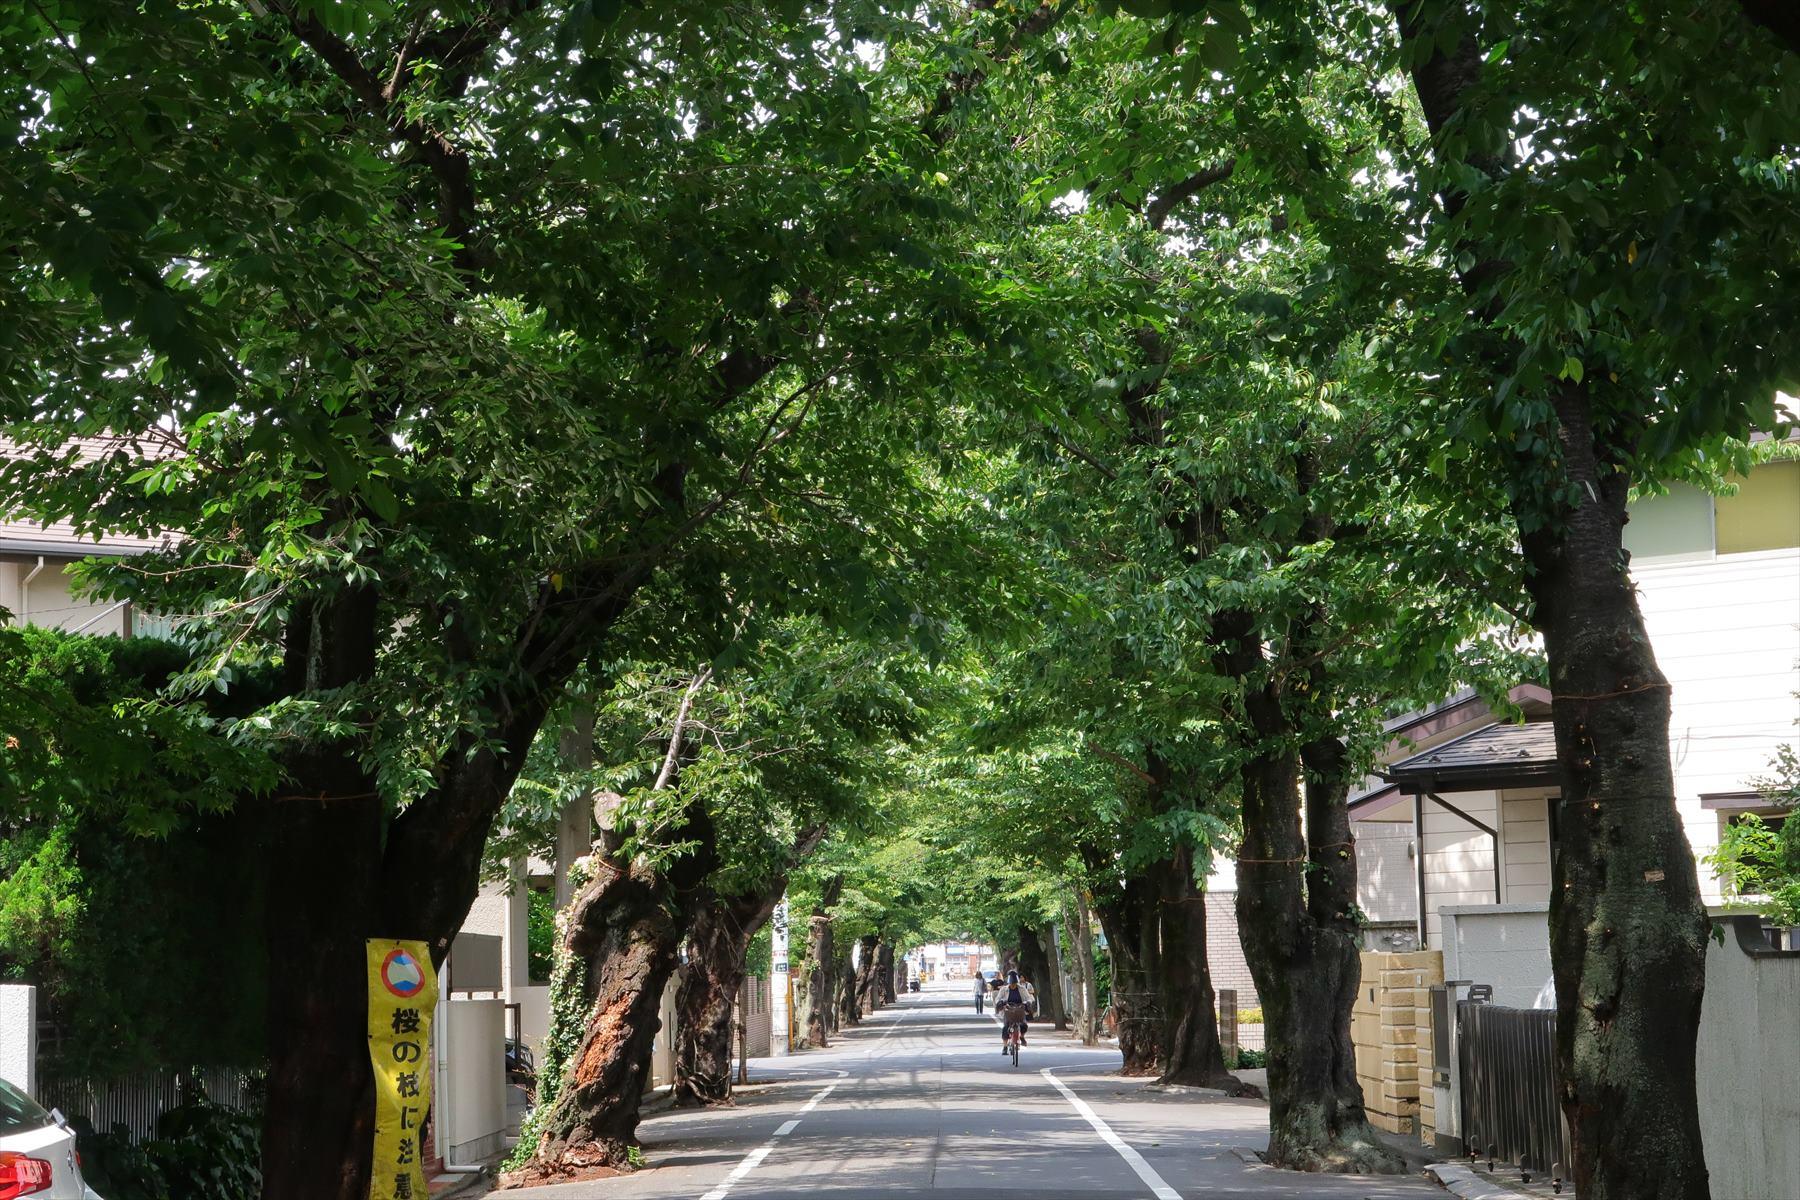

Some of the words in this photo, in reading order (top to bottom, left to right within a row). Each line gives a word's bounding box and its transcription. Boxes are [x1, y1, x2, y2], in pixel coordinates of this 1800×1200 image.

[391, 1007, 421, 1200] 桜の枝に注意
